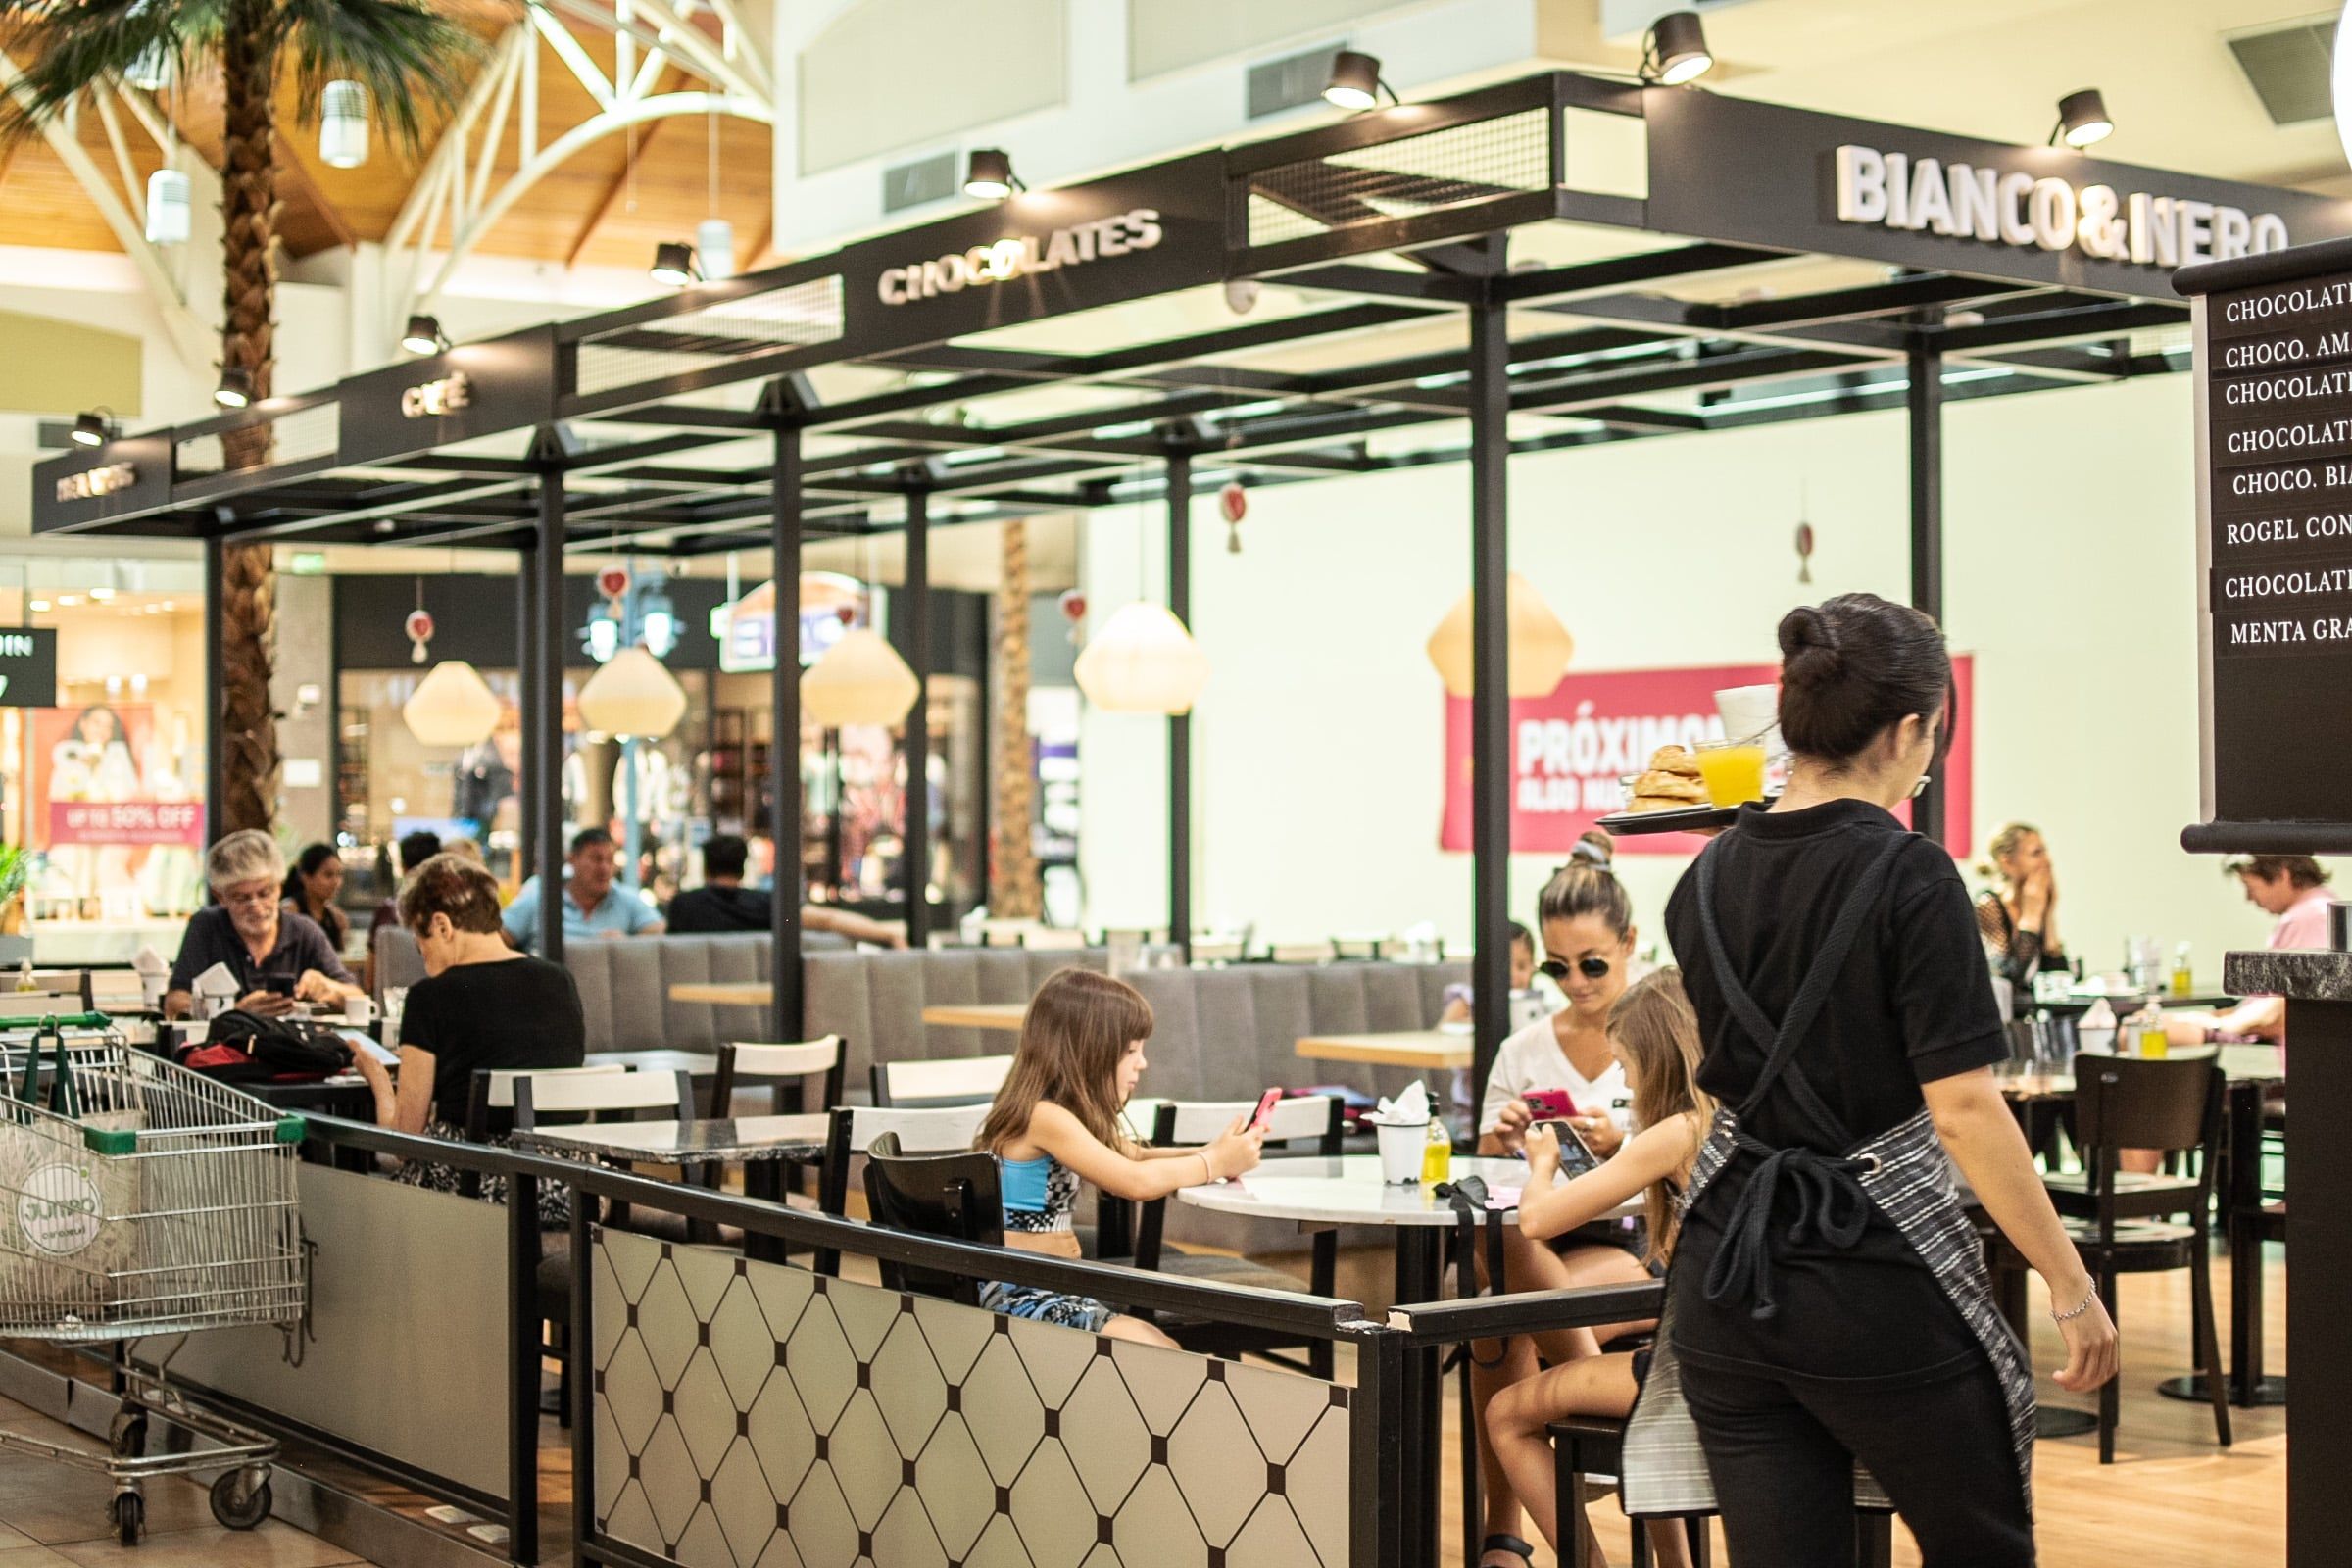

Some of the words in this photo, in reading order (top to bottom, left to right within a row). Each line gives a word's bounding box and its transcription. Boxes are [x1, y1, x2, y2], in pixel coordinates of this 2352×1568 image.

[878, 208, 1163, 305] CHOCOLATES
[2226, 281, 2352, 322] CHOCOLAT
[2226, 339, 2310, 368] CHOCO.
[2316, 331, 2352, 357] AM
[2226, 370, 2352, 405] CHOCOLAT
[2228, 419, 2352, 453] CHOCOLAT
[2232, 468, 2317, 495] CHOCO.
[2227, 518, 2299, 545] ROGEL
[2230, 620, 2307, 644] MENTA
[157, 805, 194, 830] OFF
